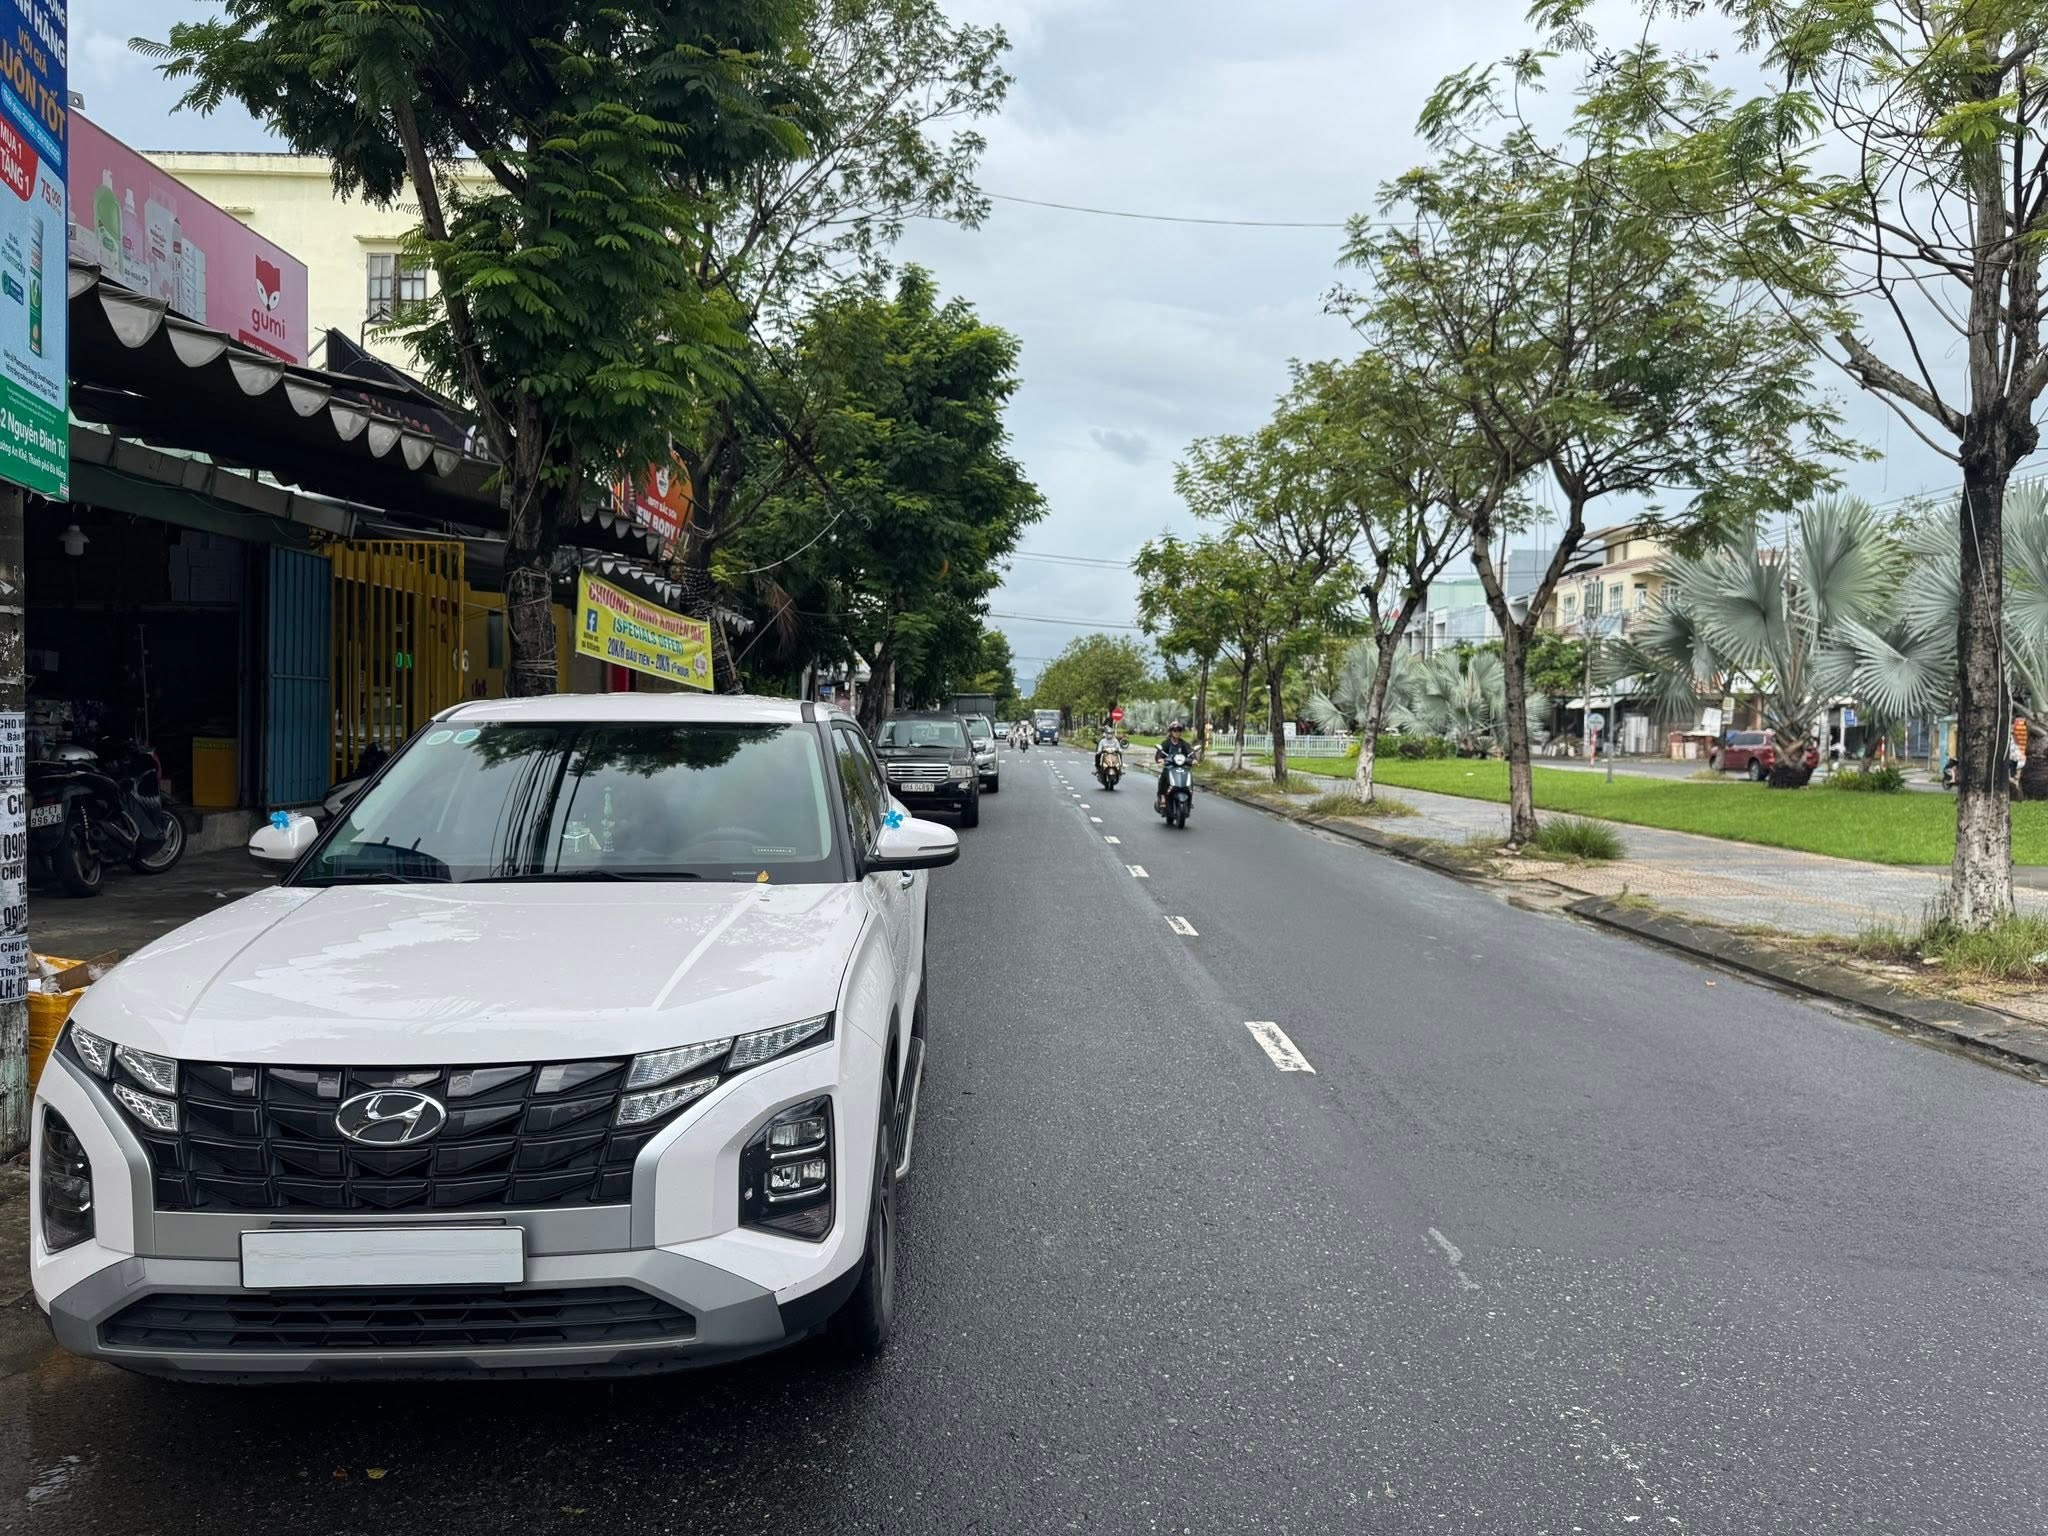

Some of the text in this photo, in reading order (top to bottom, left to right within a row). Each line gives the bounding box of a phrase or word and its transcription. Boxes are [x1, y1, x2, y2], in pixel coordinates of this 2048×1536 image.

[17, 25, 48, 79] VỚI GIÁ
[33, 3, 66, 69] HÃNG
[0, 38, 66, 141] UÔN TỐT
[0, 120, 17, 156] MUA
[0, 146, 24, 191] TẶNG
[252, 308, 286, 341] gumi
[0, 406, 7, 429] 2
[7, 411, 38, 446] Nguyễn
[39, 428, 57, 455] Đình
[652, 514, 677, 541] BODY
[612, 616, 684, 657] (SPECIALS OFFER)
[2, 864, 22, 881] CHO
[0, 941, 20, 953] CHO
